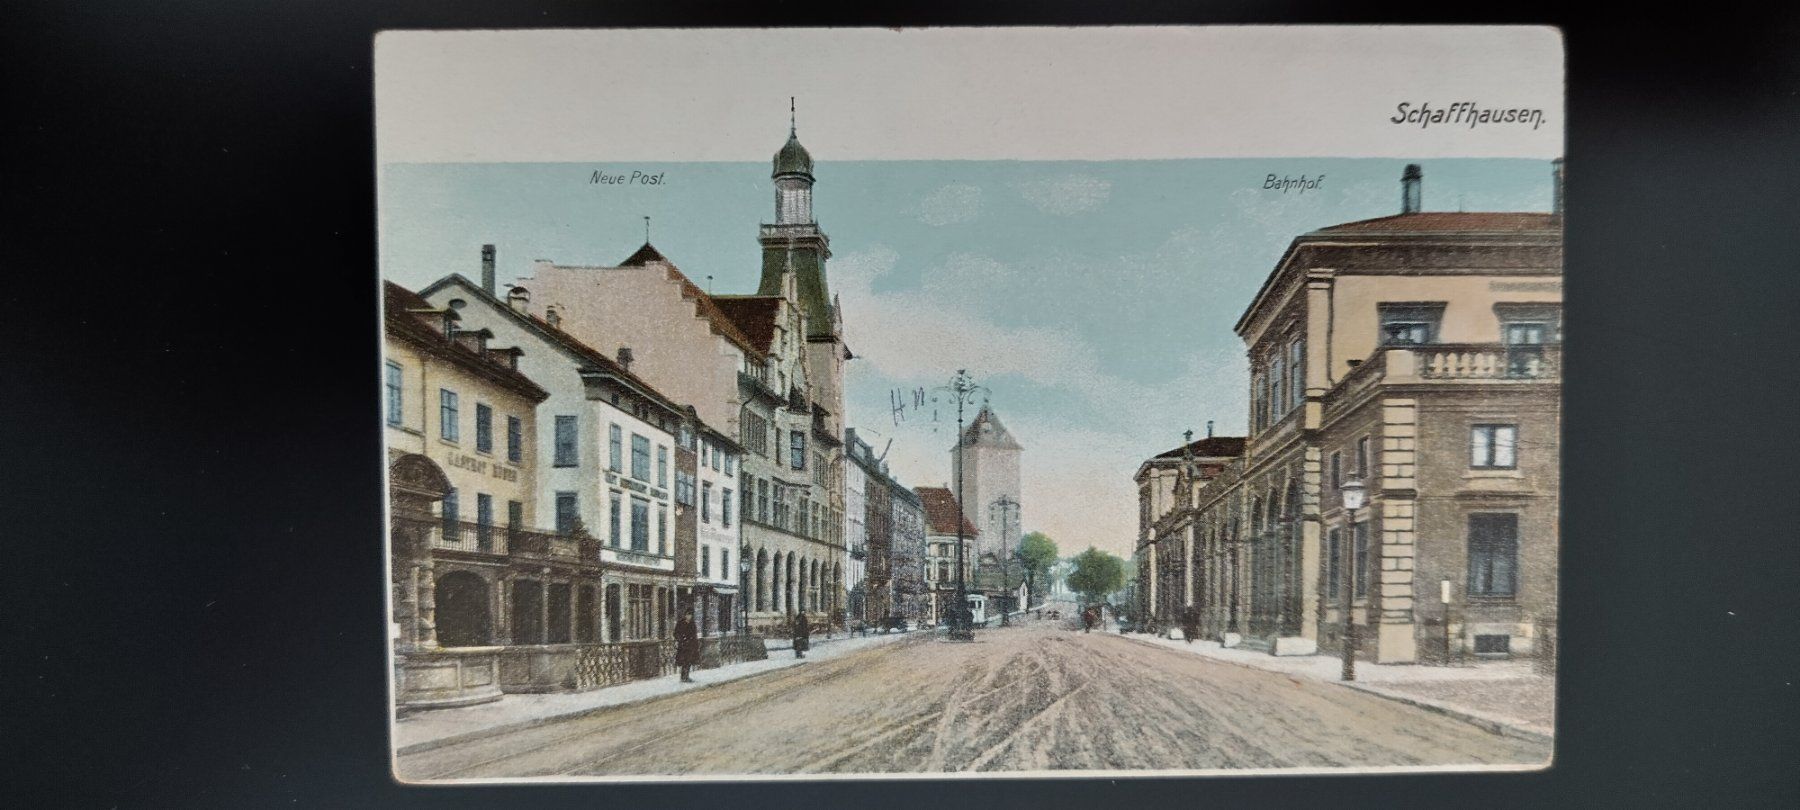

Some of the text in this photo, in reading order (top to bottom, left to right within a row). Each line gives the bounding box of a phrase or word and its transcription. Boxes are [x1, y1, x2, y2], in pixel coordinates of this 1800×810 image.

[1390, 101, 1547, 131] Schaffhausen.
[589, 169, 667, 186] Neue Post.
[1262, 173, 1326, 195] Bahnhof.
